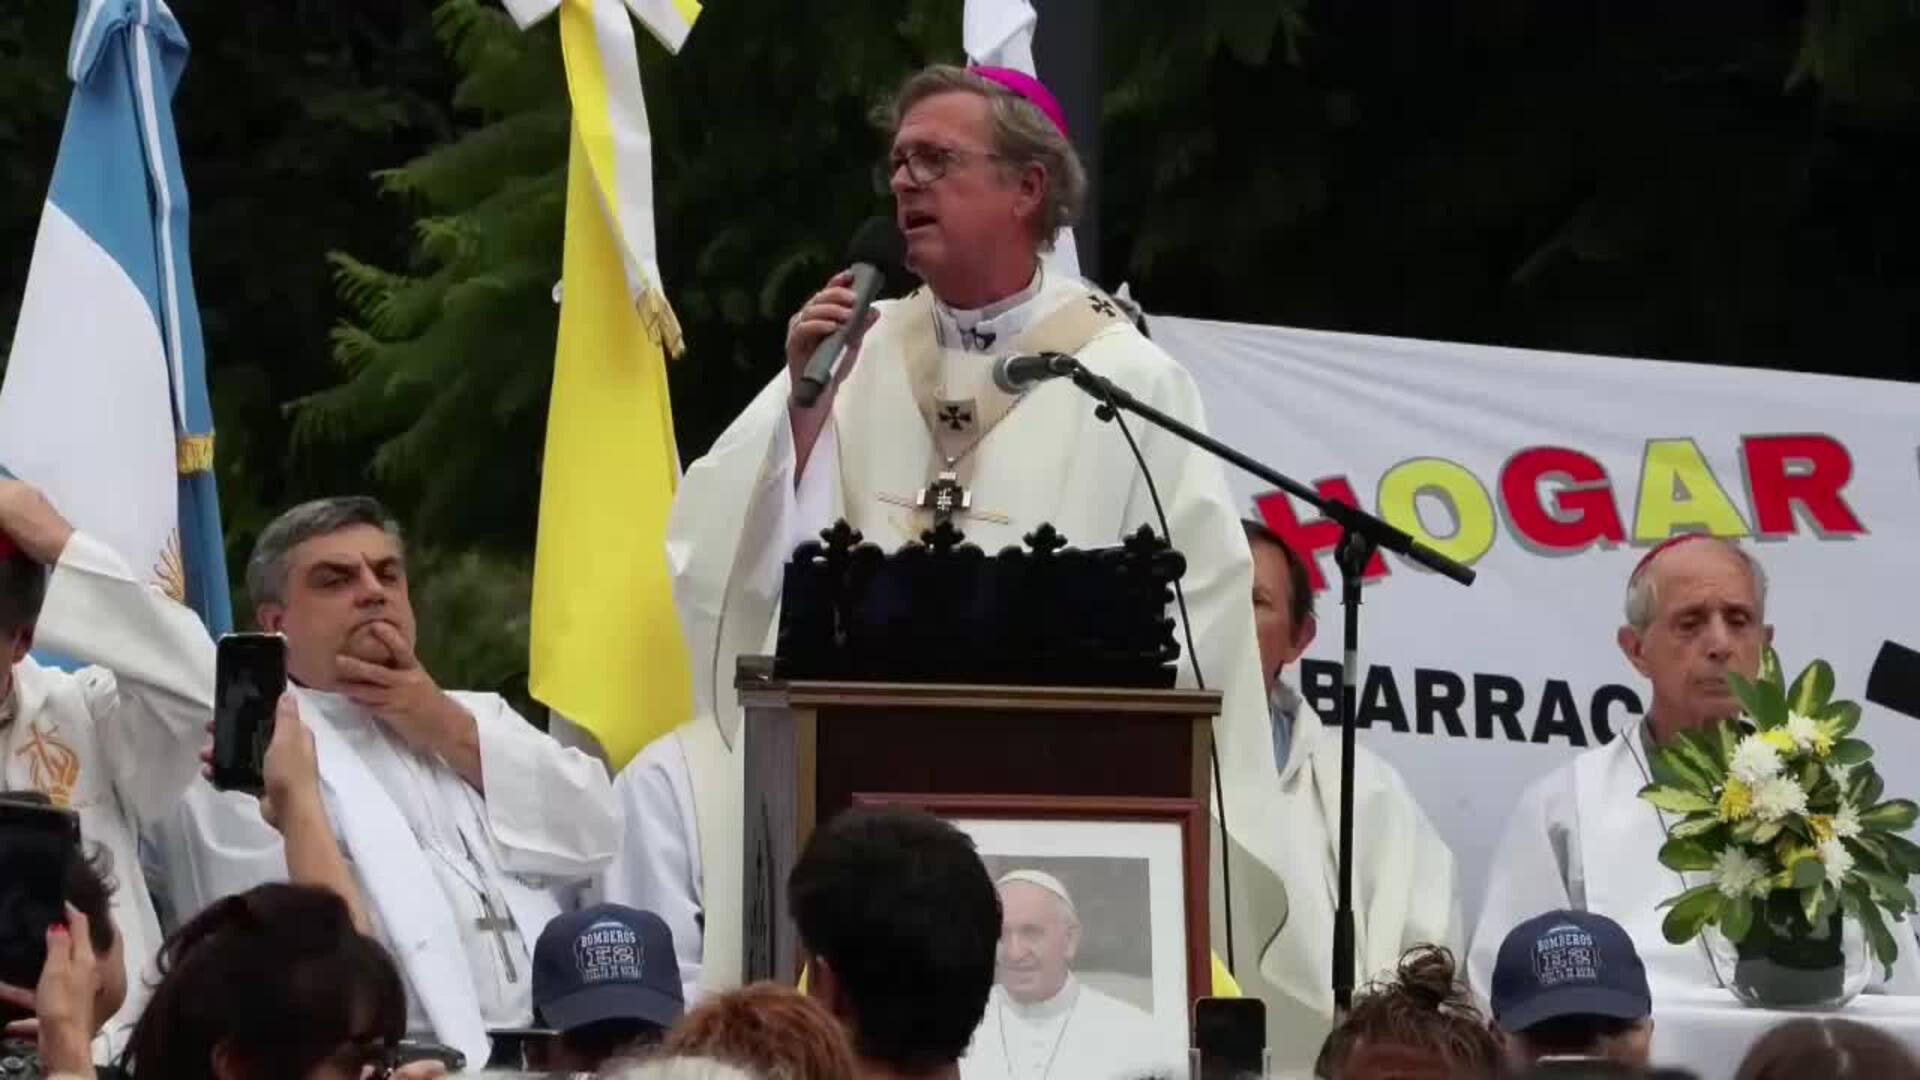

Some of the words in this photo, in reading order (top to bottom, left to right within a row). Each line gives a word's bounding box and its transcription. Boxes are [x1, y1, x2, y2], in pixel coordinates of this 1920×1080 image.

[1252, 432, 1868, 592] HOGAR
[580, 930, 636, 948] BOMBEROS
[1537, 934, 1593, 953] BOMBEROS
